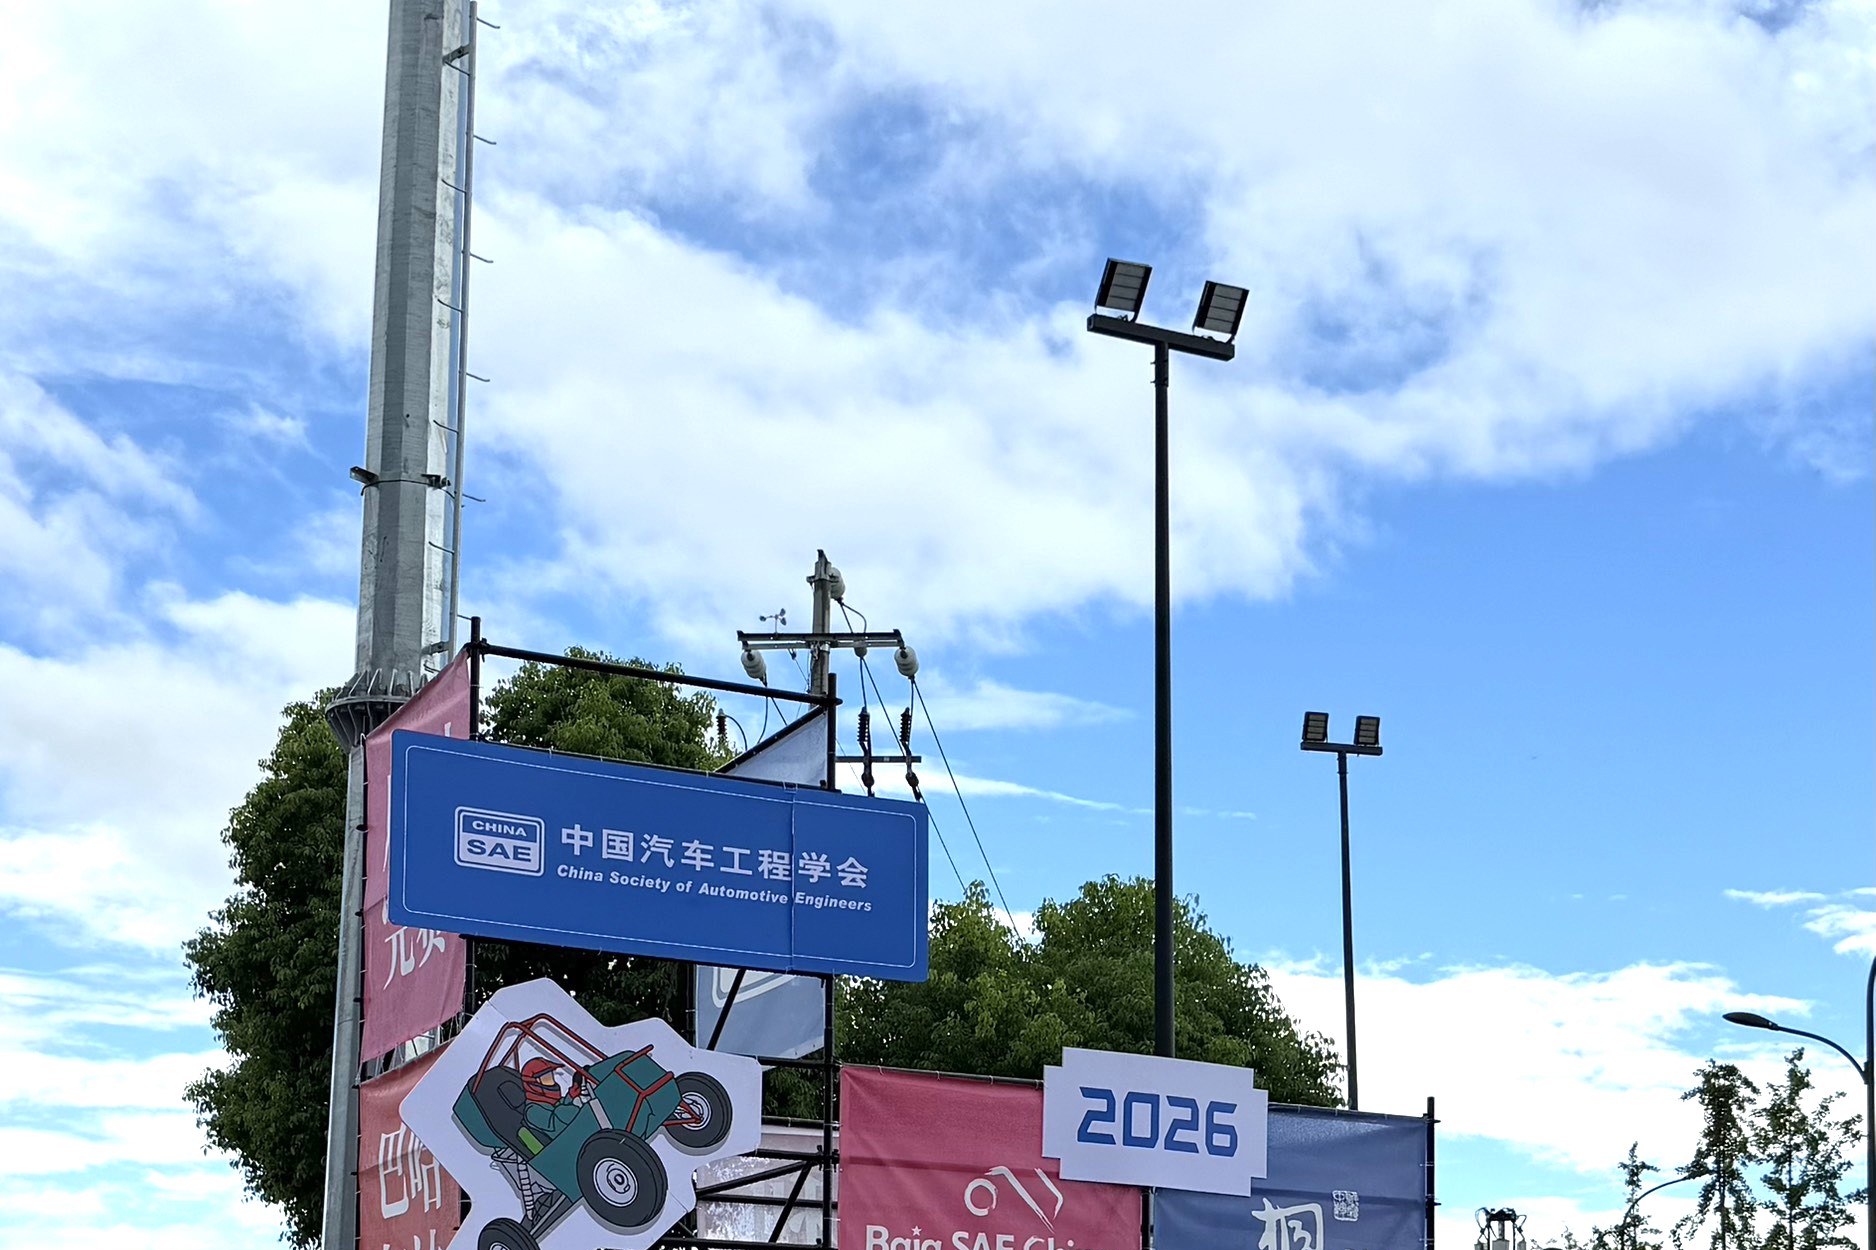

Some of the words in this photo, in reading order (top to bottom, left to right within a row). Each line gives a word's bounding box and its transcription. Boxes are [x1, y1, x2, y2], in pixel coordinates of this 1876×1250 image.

[467, 839, 533, 863] SAE
[472, 820, 528, 837] CHINA
[561, 824, 869, 889] 中国汽车工程学会
[557, 864, 604, 882] China
[609, 871, 671, 893] Society
[676, 880, 693, 893] of
[699, 882, 789, 904] Automotive
[794, 891, 873, 912] Engineers
[1077, 1086, 1238, 1157] 2026
